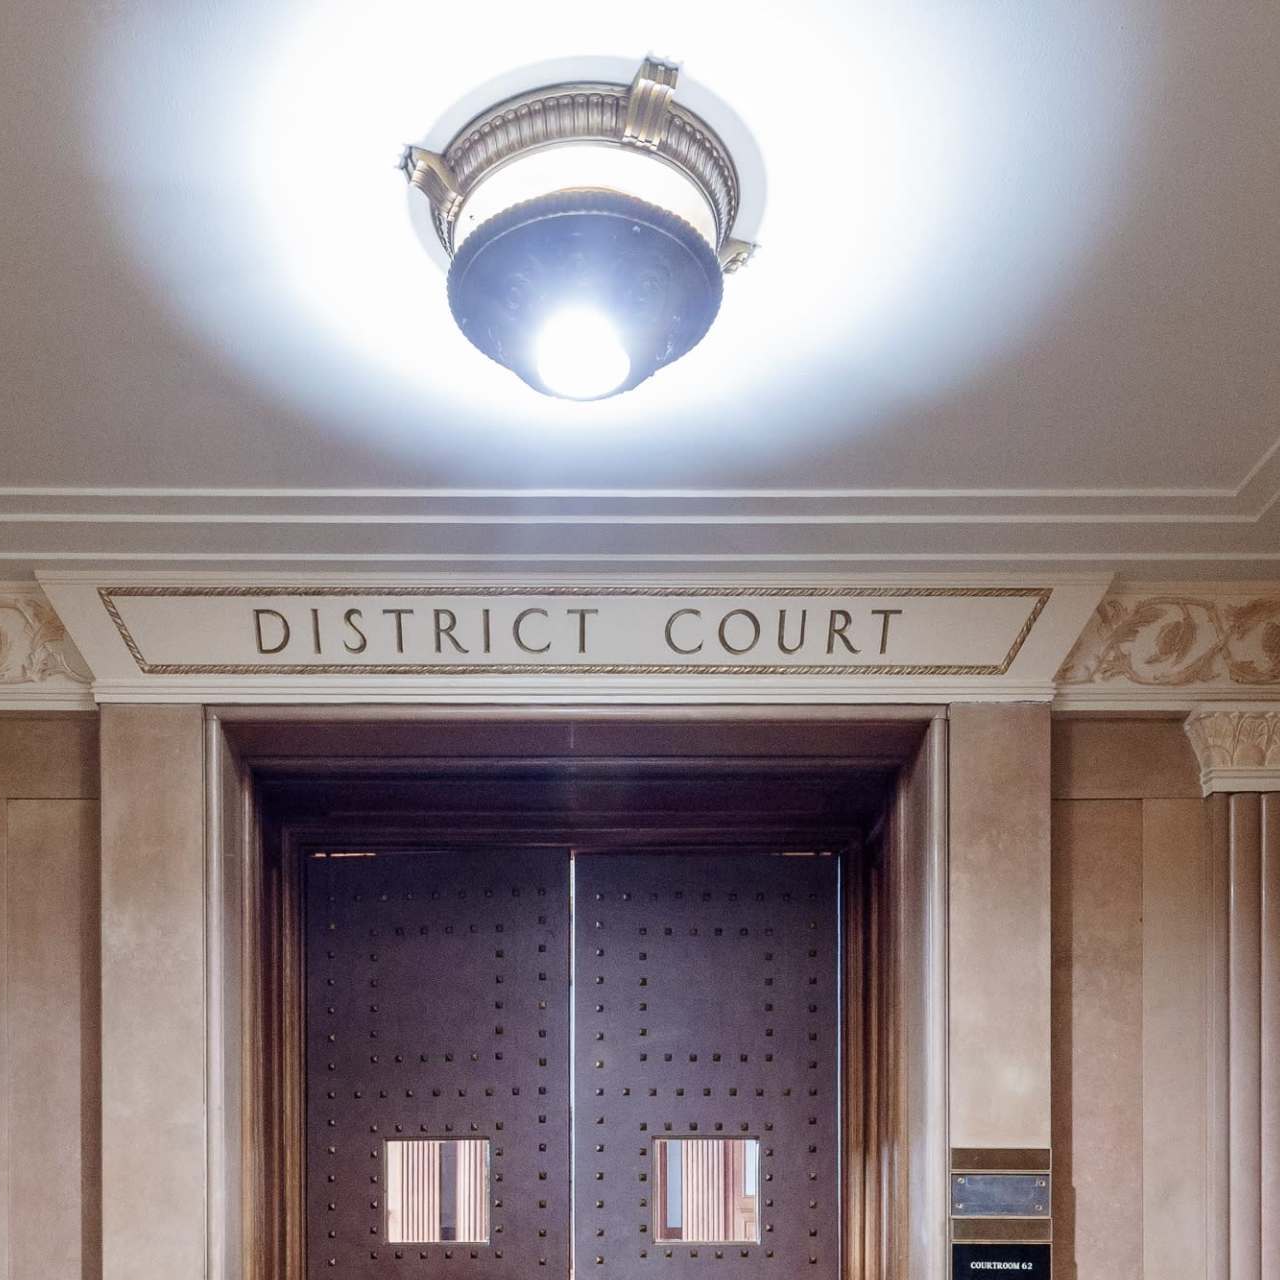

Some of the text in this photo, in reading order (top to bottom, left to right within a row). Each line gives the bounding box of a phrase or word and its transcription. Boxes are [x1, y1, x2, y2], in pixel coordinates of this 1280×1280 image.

[254, 607, 901, 656] DISTRICT COURT
[970, 1261, 1020, 1270] COURTROOM
